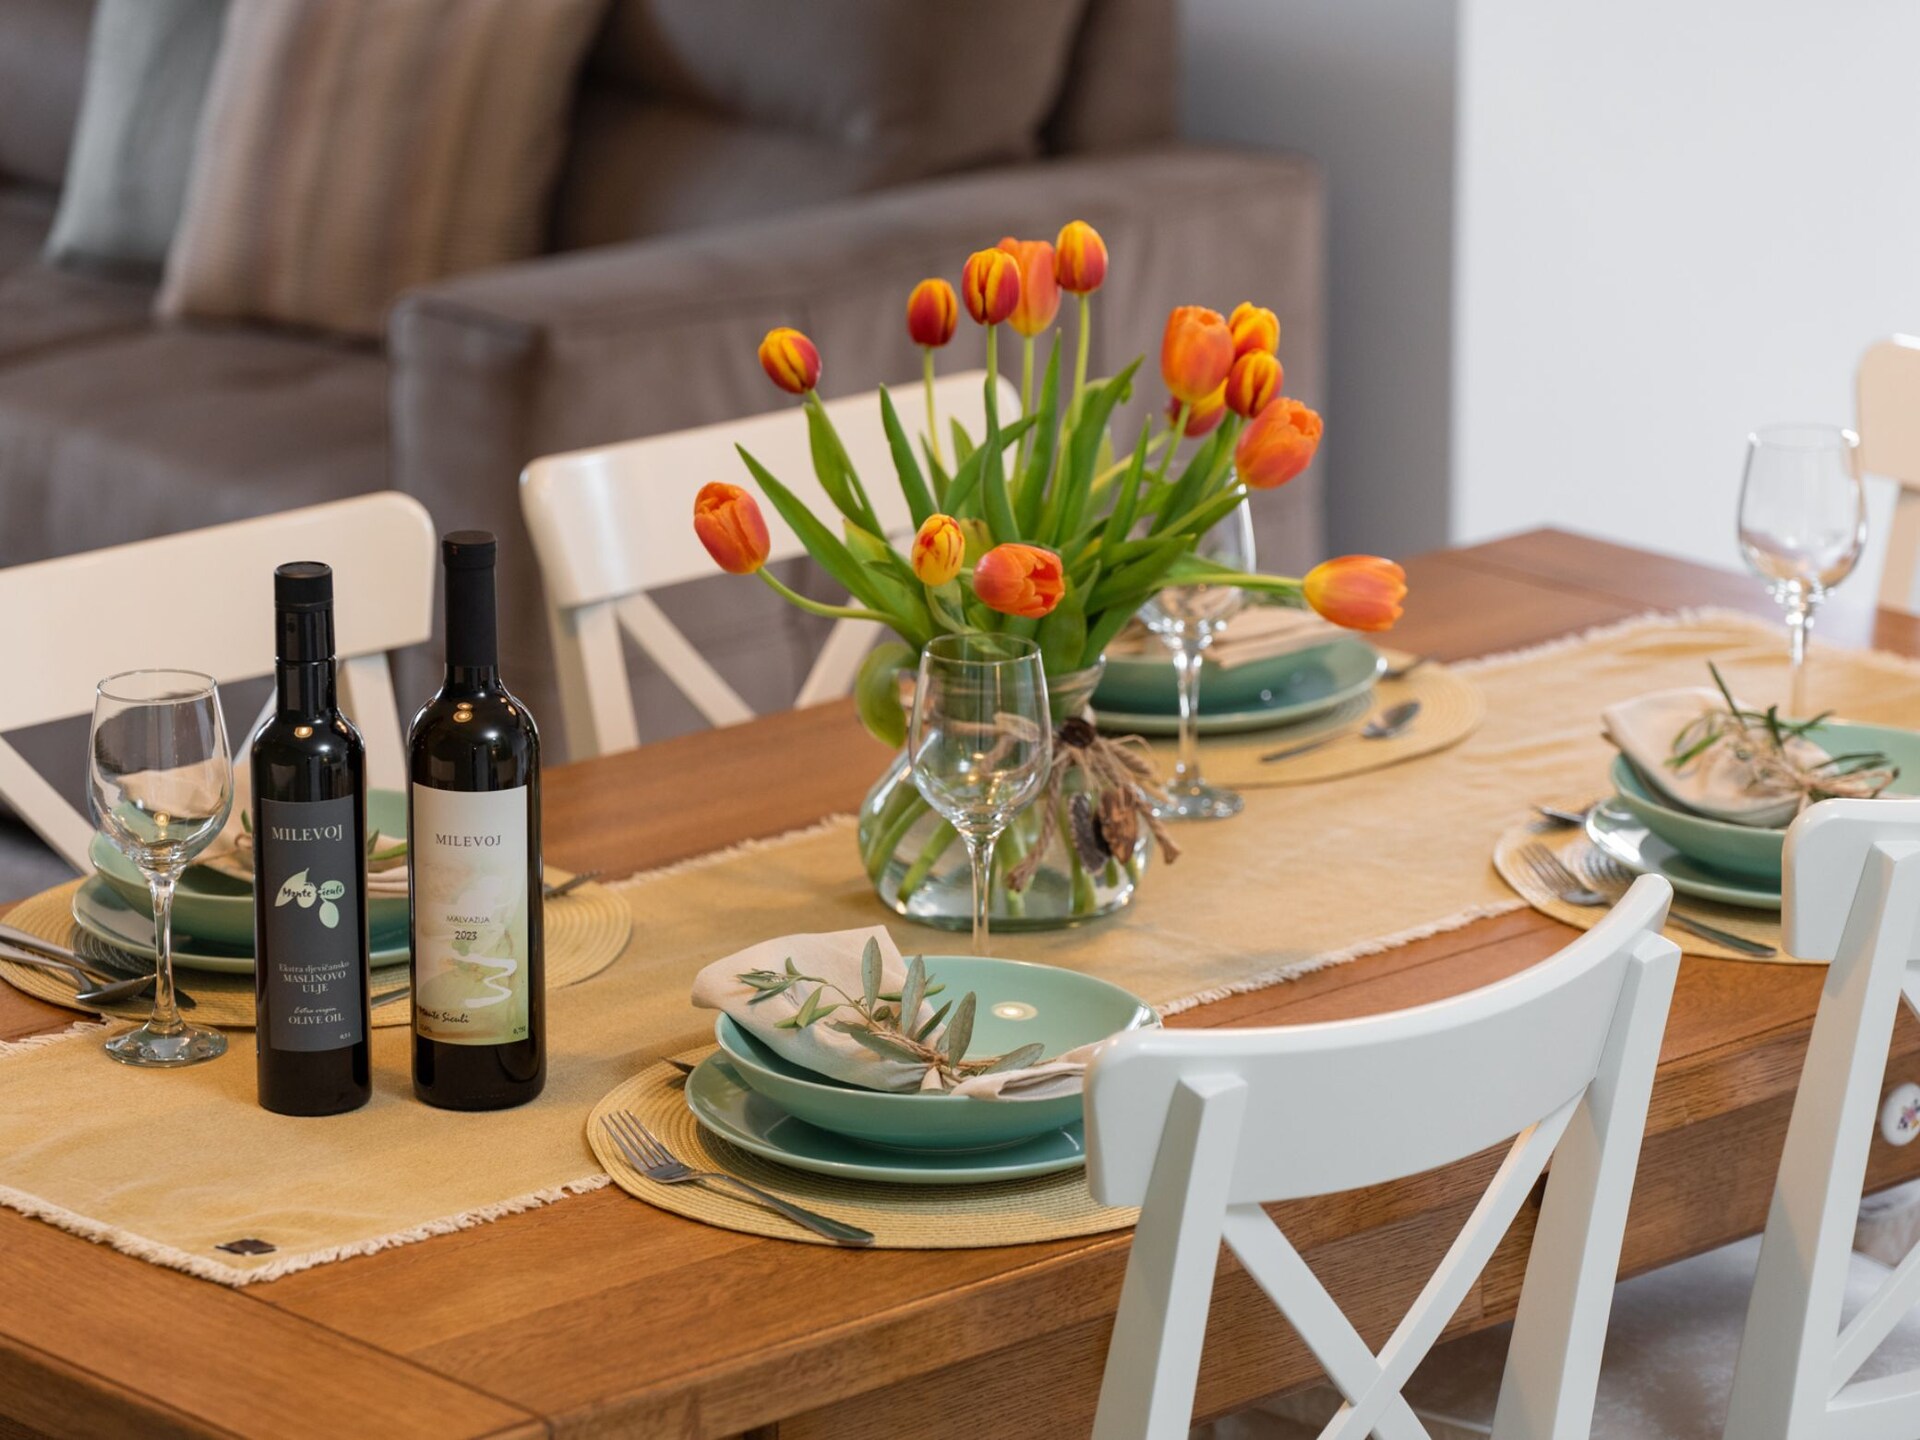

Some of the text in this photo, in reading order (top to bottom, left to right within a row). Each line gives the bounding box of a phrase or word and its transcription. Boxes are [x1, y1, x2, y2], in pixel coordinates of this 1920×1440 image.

[272, 824, 342, 841] MILEVOJ
[435, 833, 502, 847] MILEVOJ
[454, 930, 478, 941] 2023
[283, 970, 346, 983] MASLINOVO
[302, 983, 329, 994] ULJE
[288, 1012, 345, 1025] OLIVE OIL
